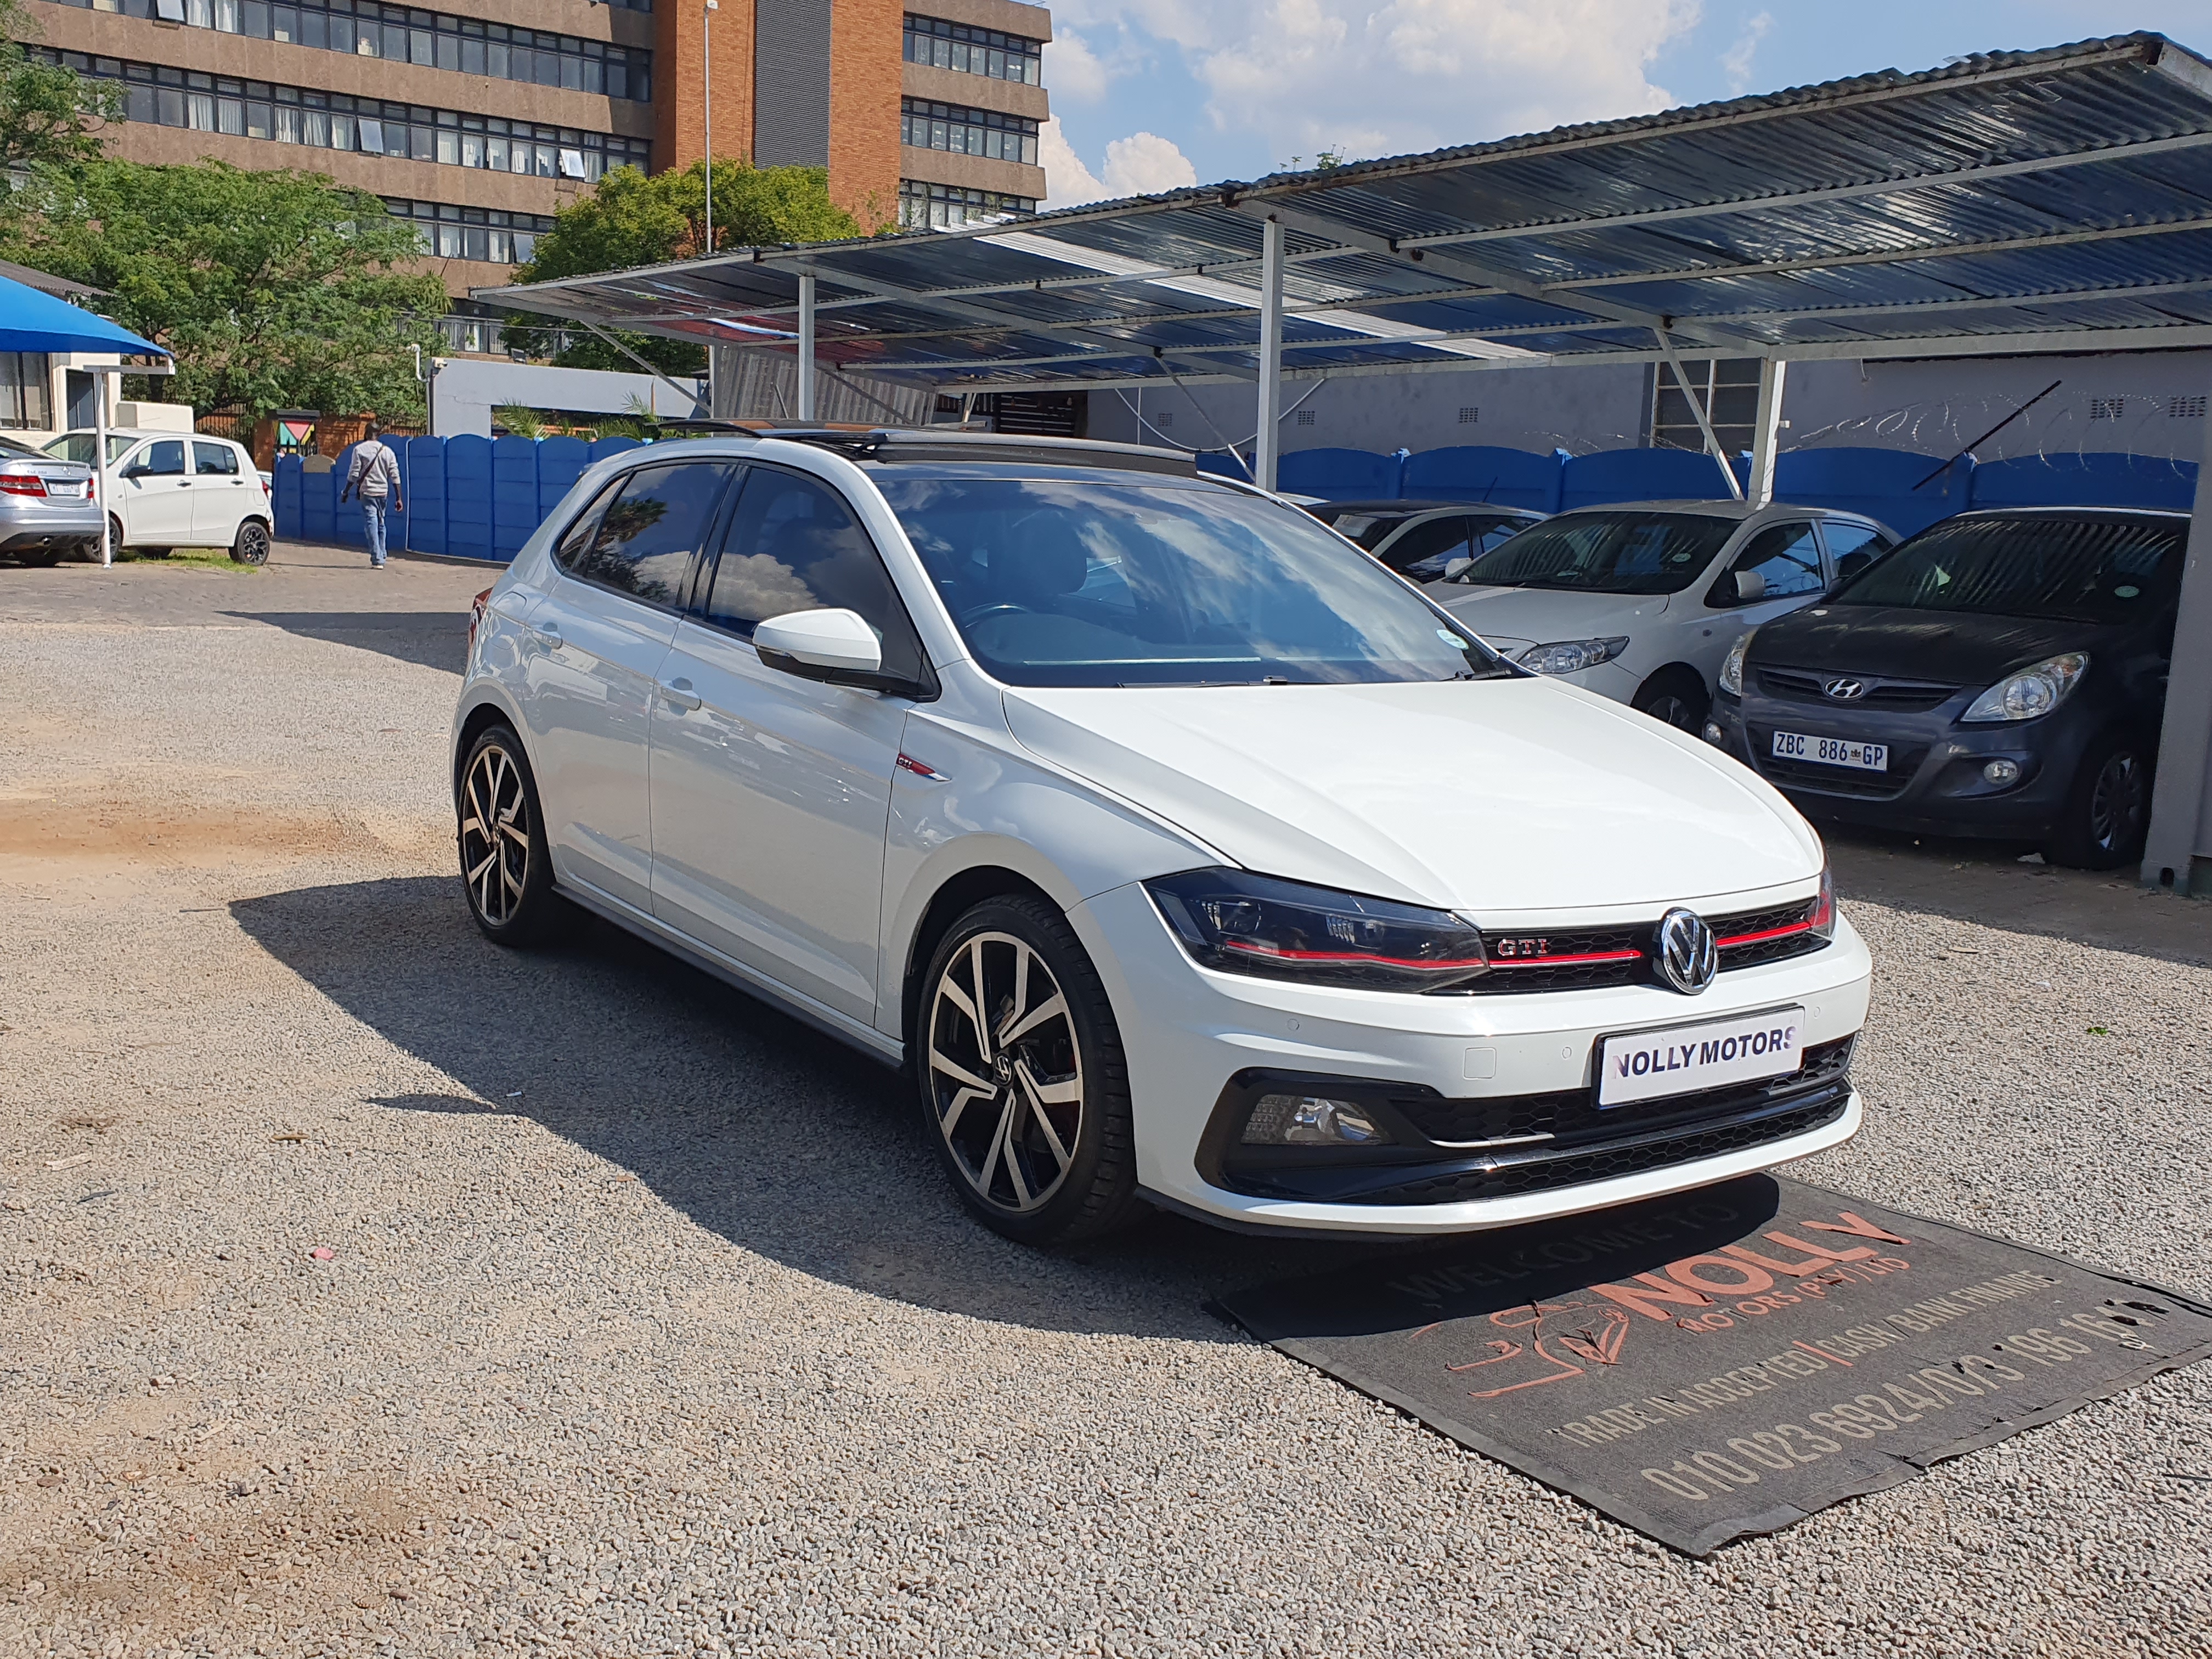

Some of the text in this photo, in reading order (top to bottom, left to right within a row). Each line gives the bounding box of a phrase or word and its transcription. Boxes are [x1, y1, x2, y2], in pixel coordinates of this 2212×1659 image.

[1776, 733, 1883, 766] ZBC 886 GP
[1498, 939, 1547, 956] GTI
[1612, 1026, 1797, 1079] NOLLY MOTORS
[1385, 1203, 1739, 1303] WELCOME TO
[1588, 1210, 1911, 1322] NOLLY
[1676, 1291, 1802, 1335] MOTORS
[1544, 1403, 1667, 1447] TRADE
[1642, 1395, 1700, 1417] IN
[1677, 1350, 1829, 1409] ACCEPTED
[1950, 1269, 2063, 1307] FINANCE
[1641, 1451, 1760, 1500] 010
[1726, 1424, 1843, 1470] 023
[1995, 1328, 2092, 1367] 196
